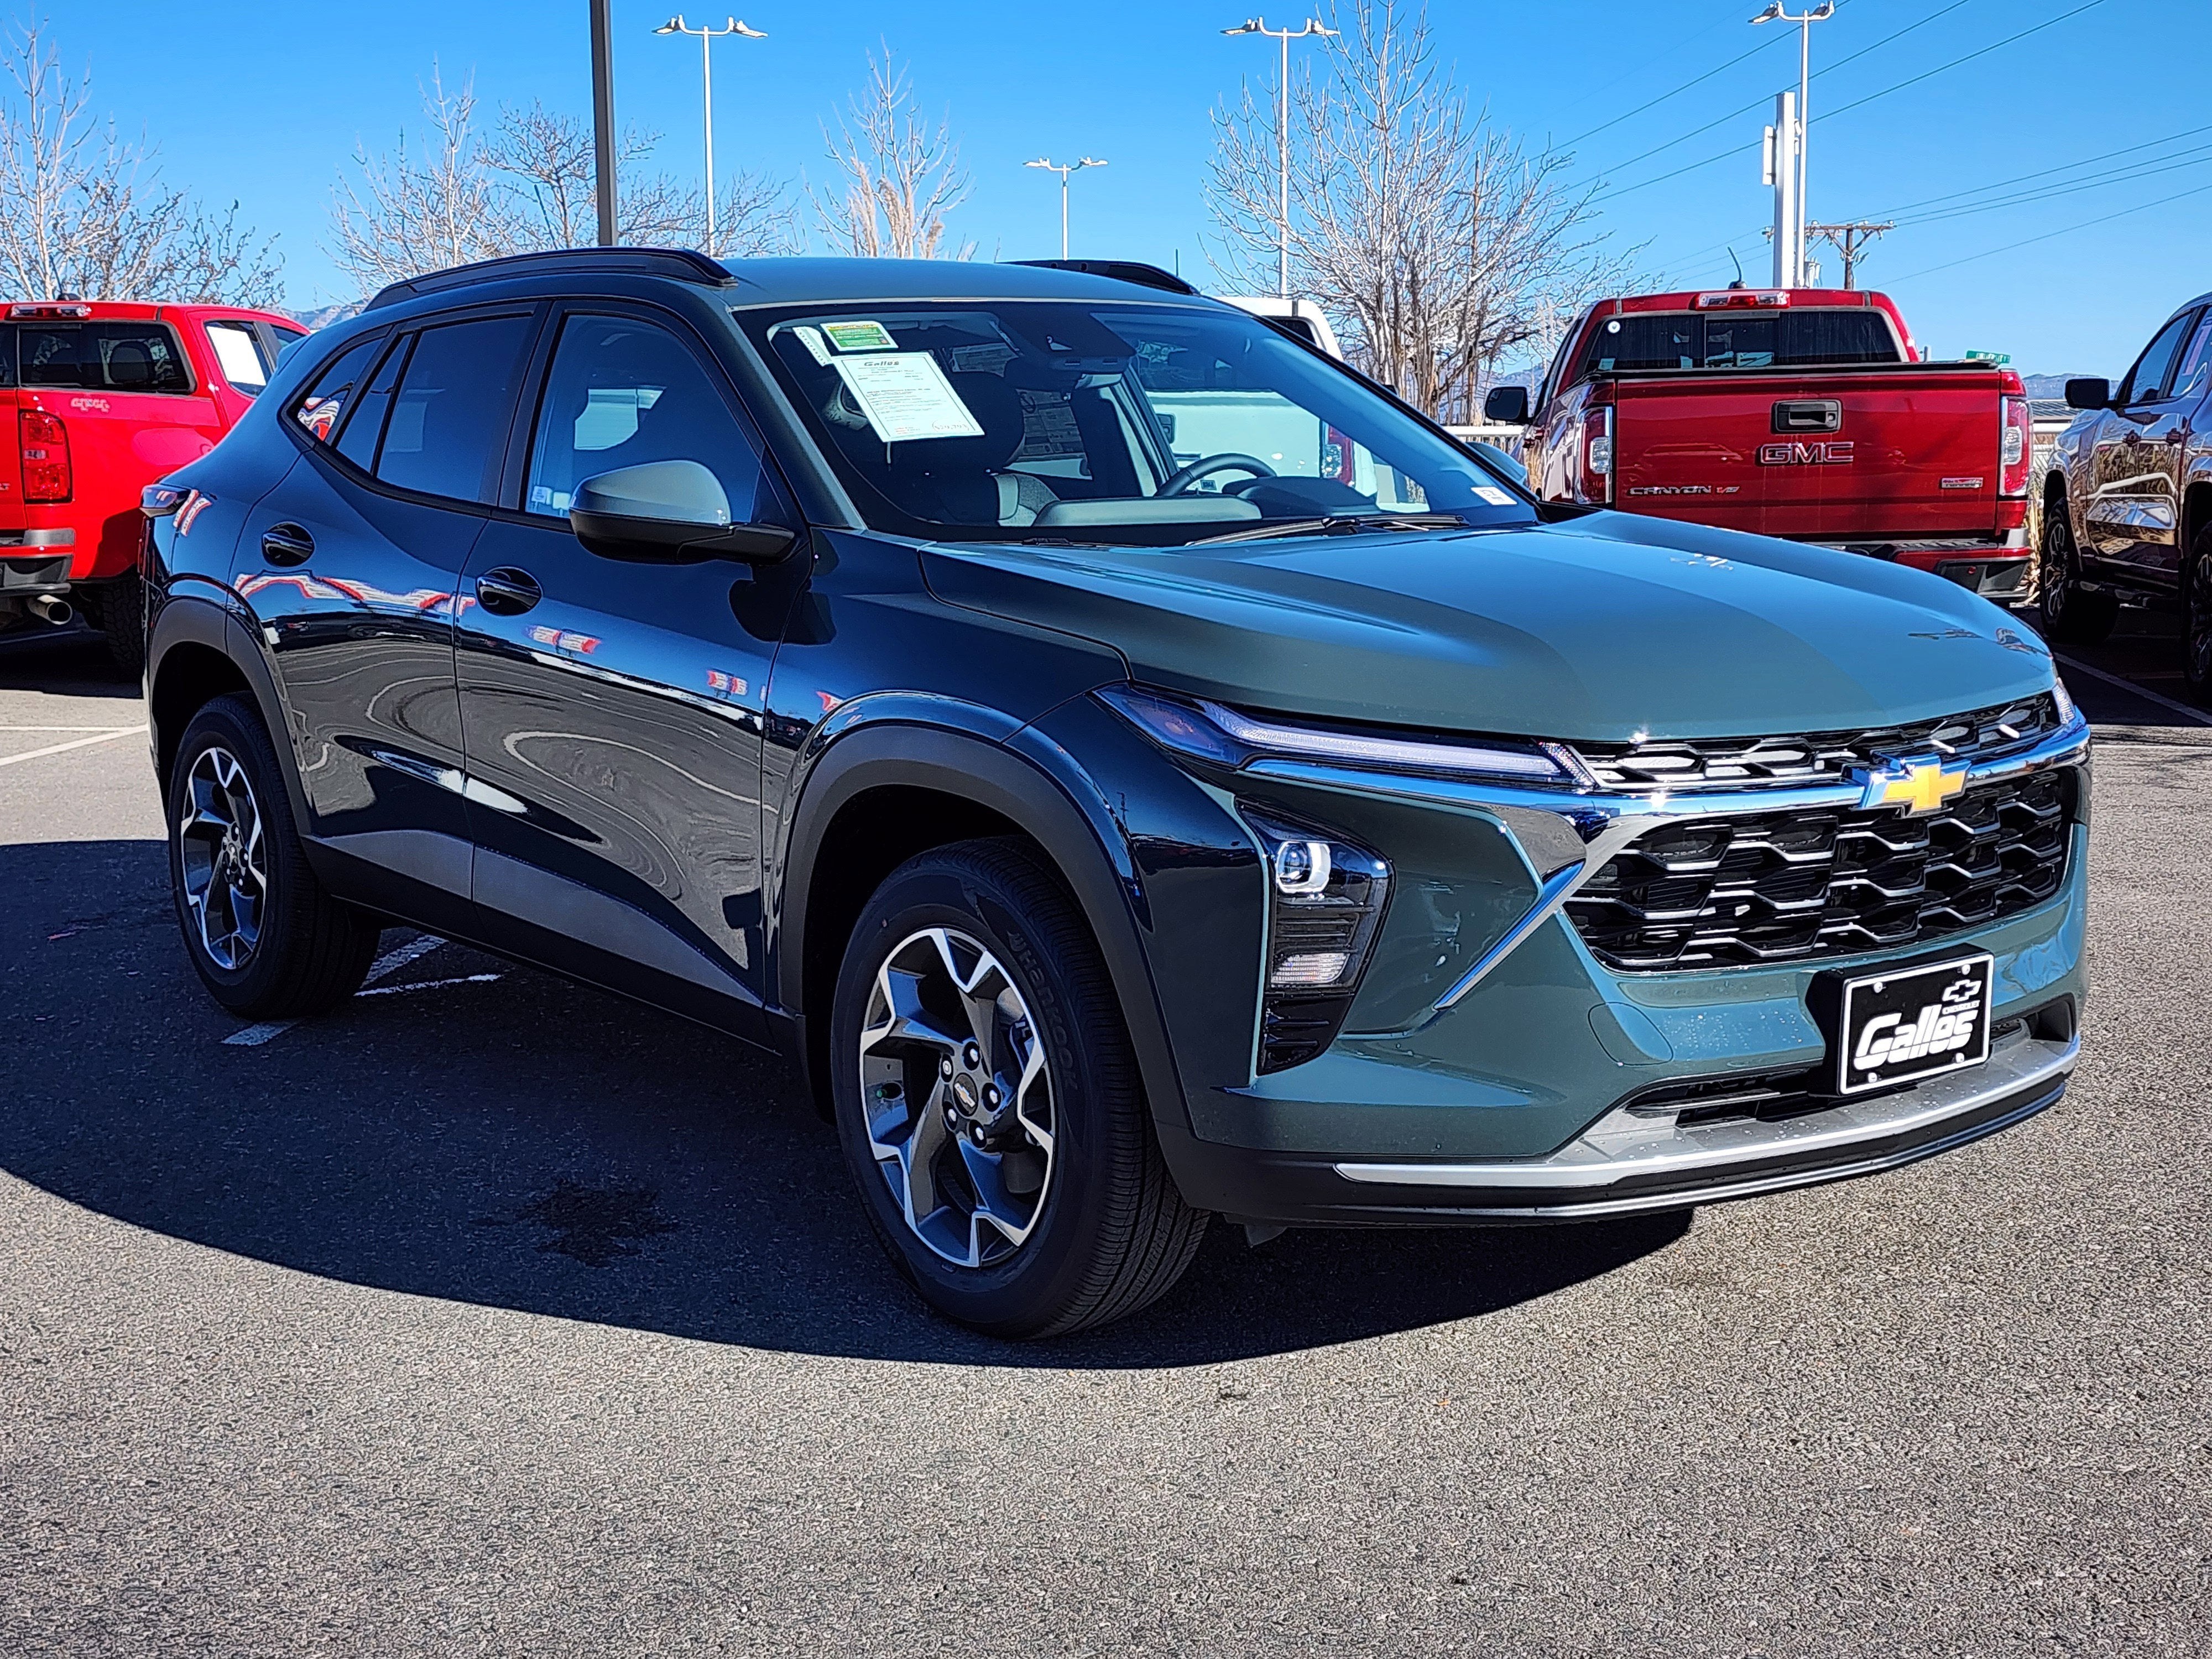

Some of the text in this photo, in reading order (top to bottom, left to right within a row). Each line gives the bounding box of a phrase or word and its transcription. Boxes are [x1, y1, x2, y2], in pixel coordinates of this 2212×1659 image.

[1760, 441, 1854, 464] GMC
[1629, 485, 1712, 495] CANYON
[1853, 1004, 1979, 1070] Galles
